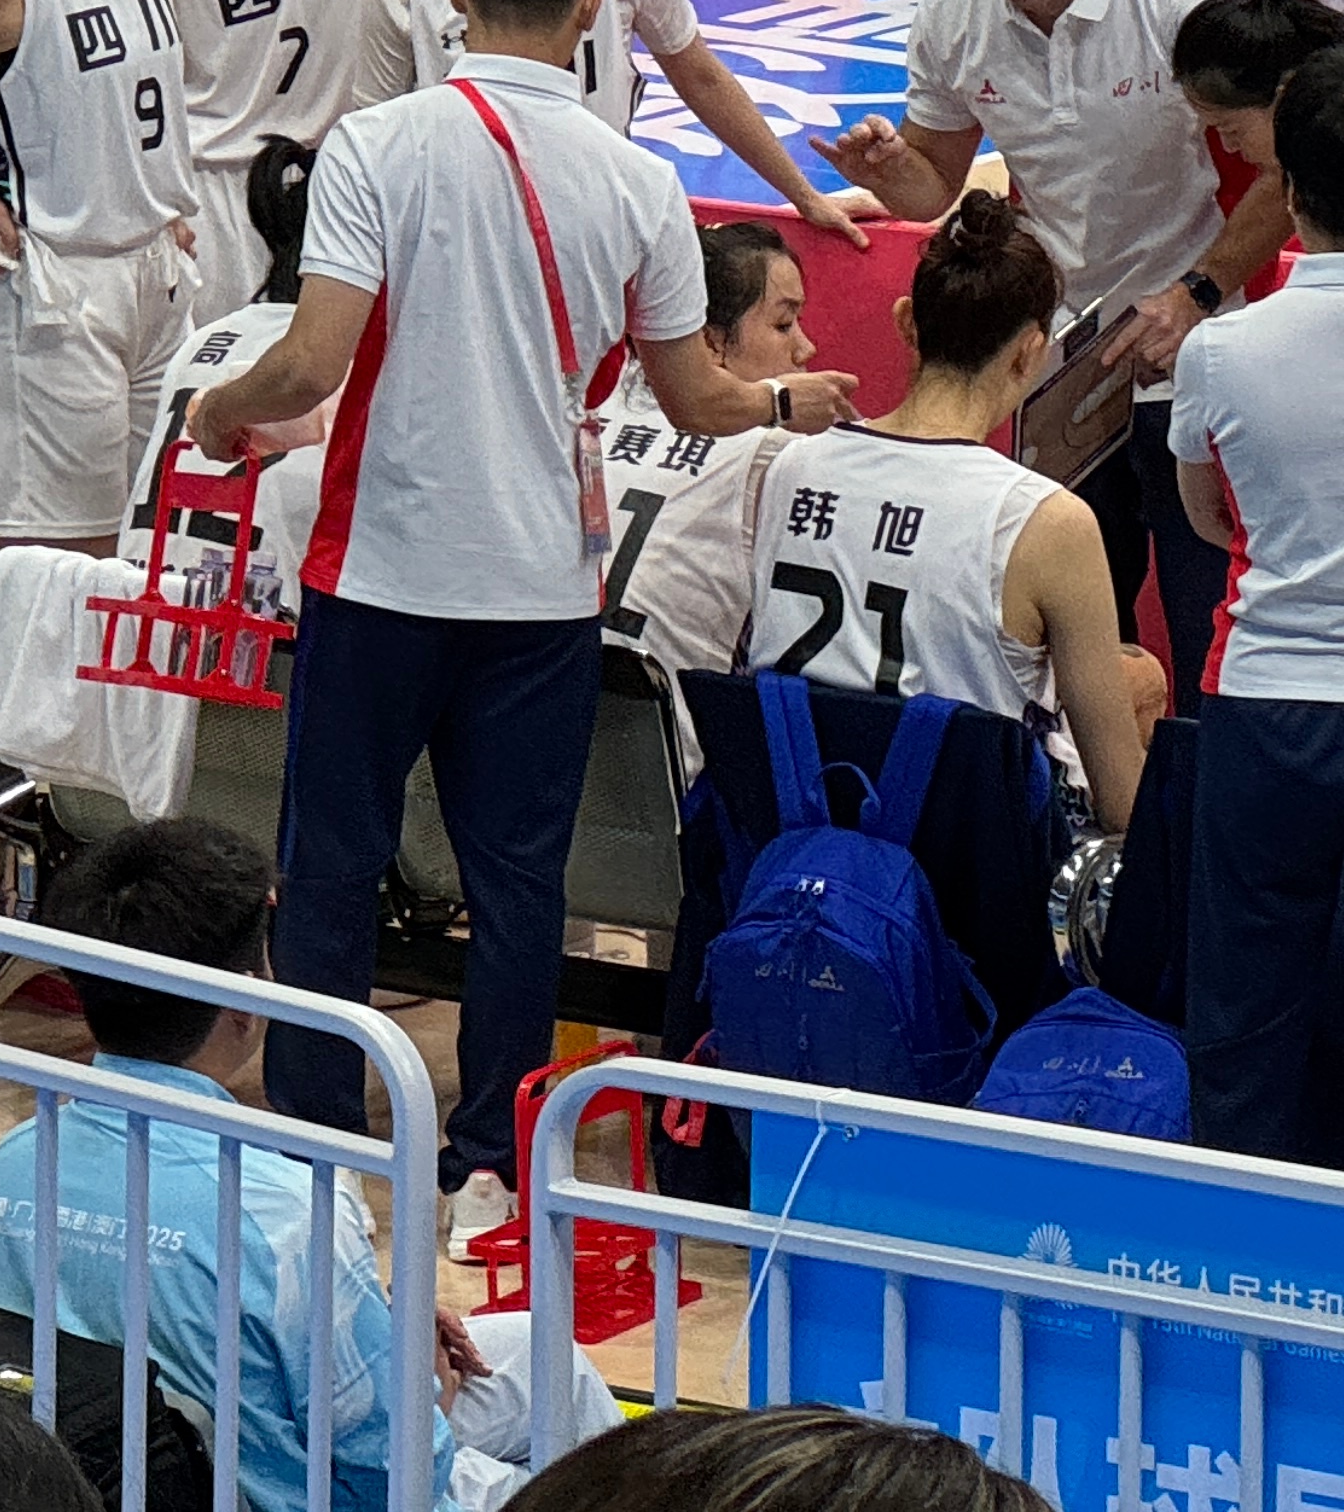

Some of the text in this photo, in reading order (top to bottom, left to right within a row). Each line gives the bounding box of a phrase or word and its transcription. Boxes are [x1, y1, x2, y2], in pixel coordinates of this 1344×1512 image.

[275, 25, 309, 95] 7
[134, 76, 166, 152] 9
[598, 416, 717, 477] 赛琪
[770, 560, 909, 696] 21
